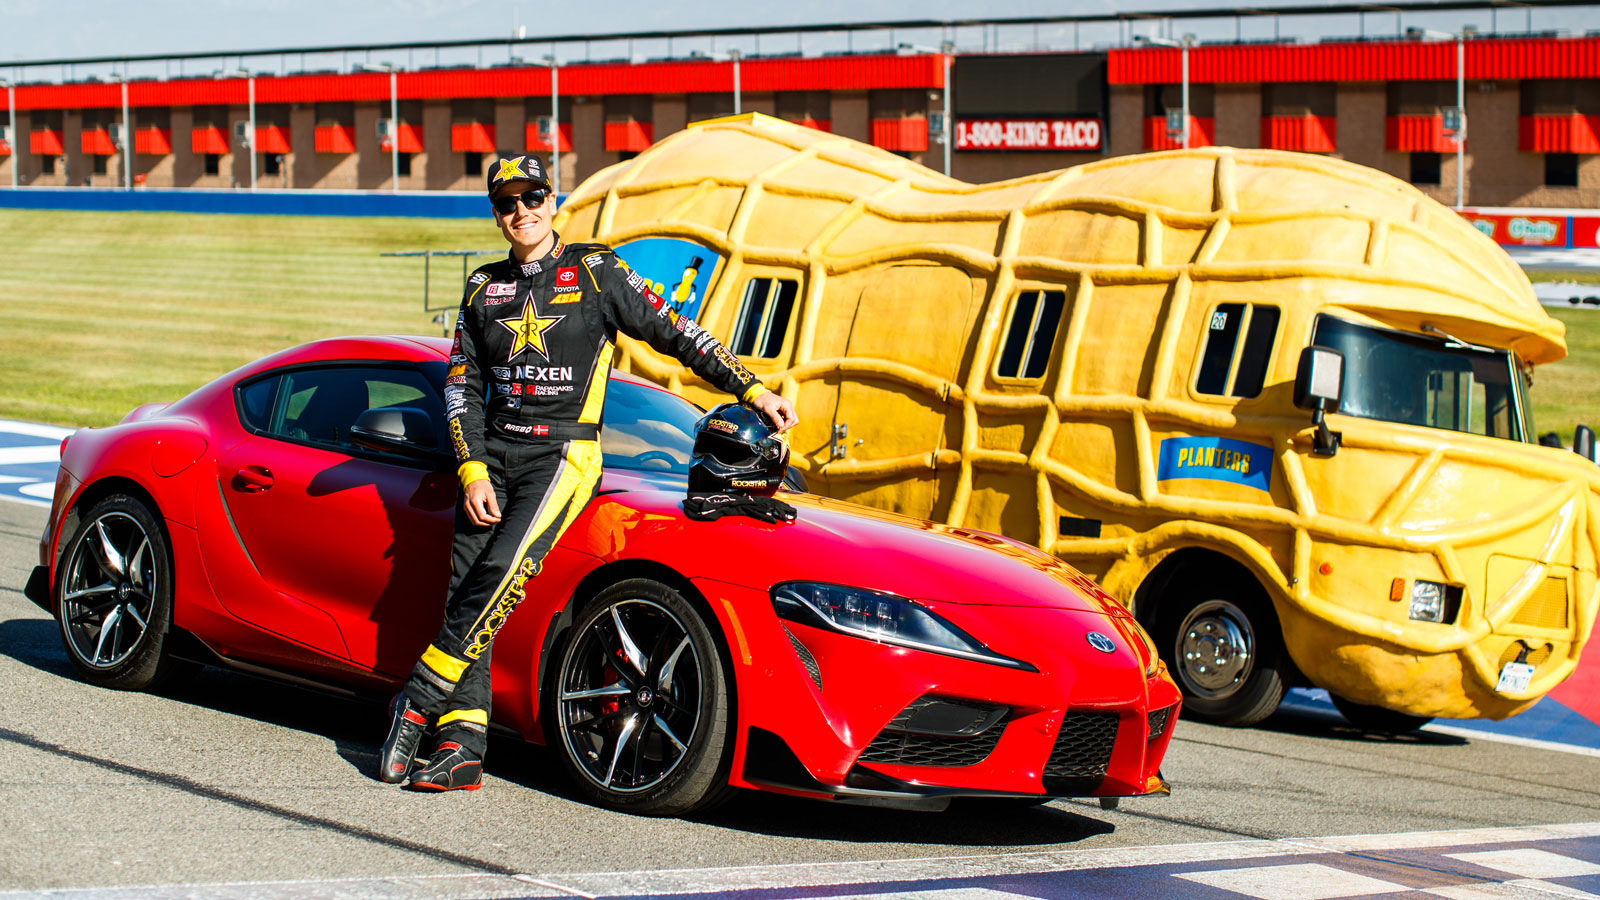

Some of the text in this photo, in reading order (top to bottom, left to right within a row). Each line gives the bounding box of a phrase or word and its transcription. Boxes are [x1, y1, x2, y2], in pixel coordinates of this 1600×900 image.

[957, 121, 1100, 147] 1-800-KING TACO
[1211, 316, 1225, 329] 20
[515, 365, 573, 381] NEXEN
[1177, 446, 1251, 474] PLANTERS
